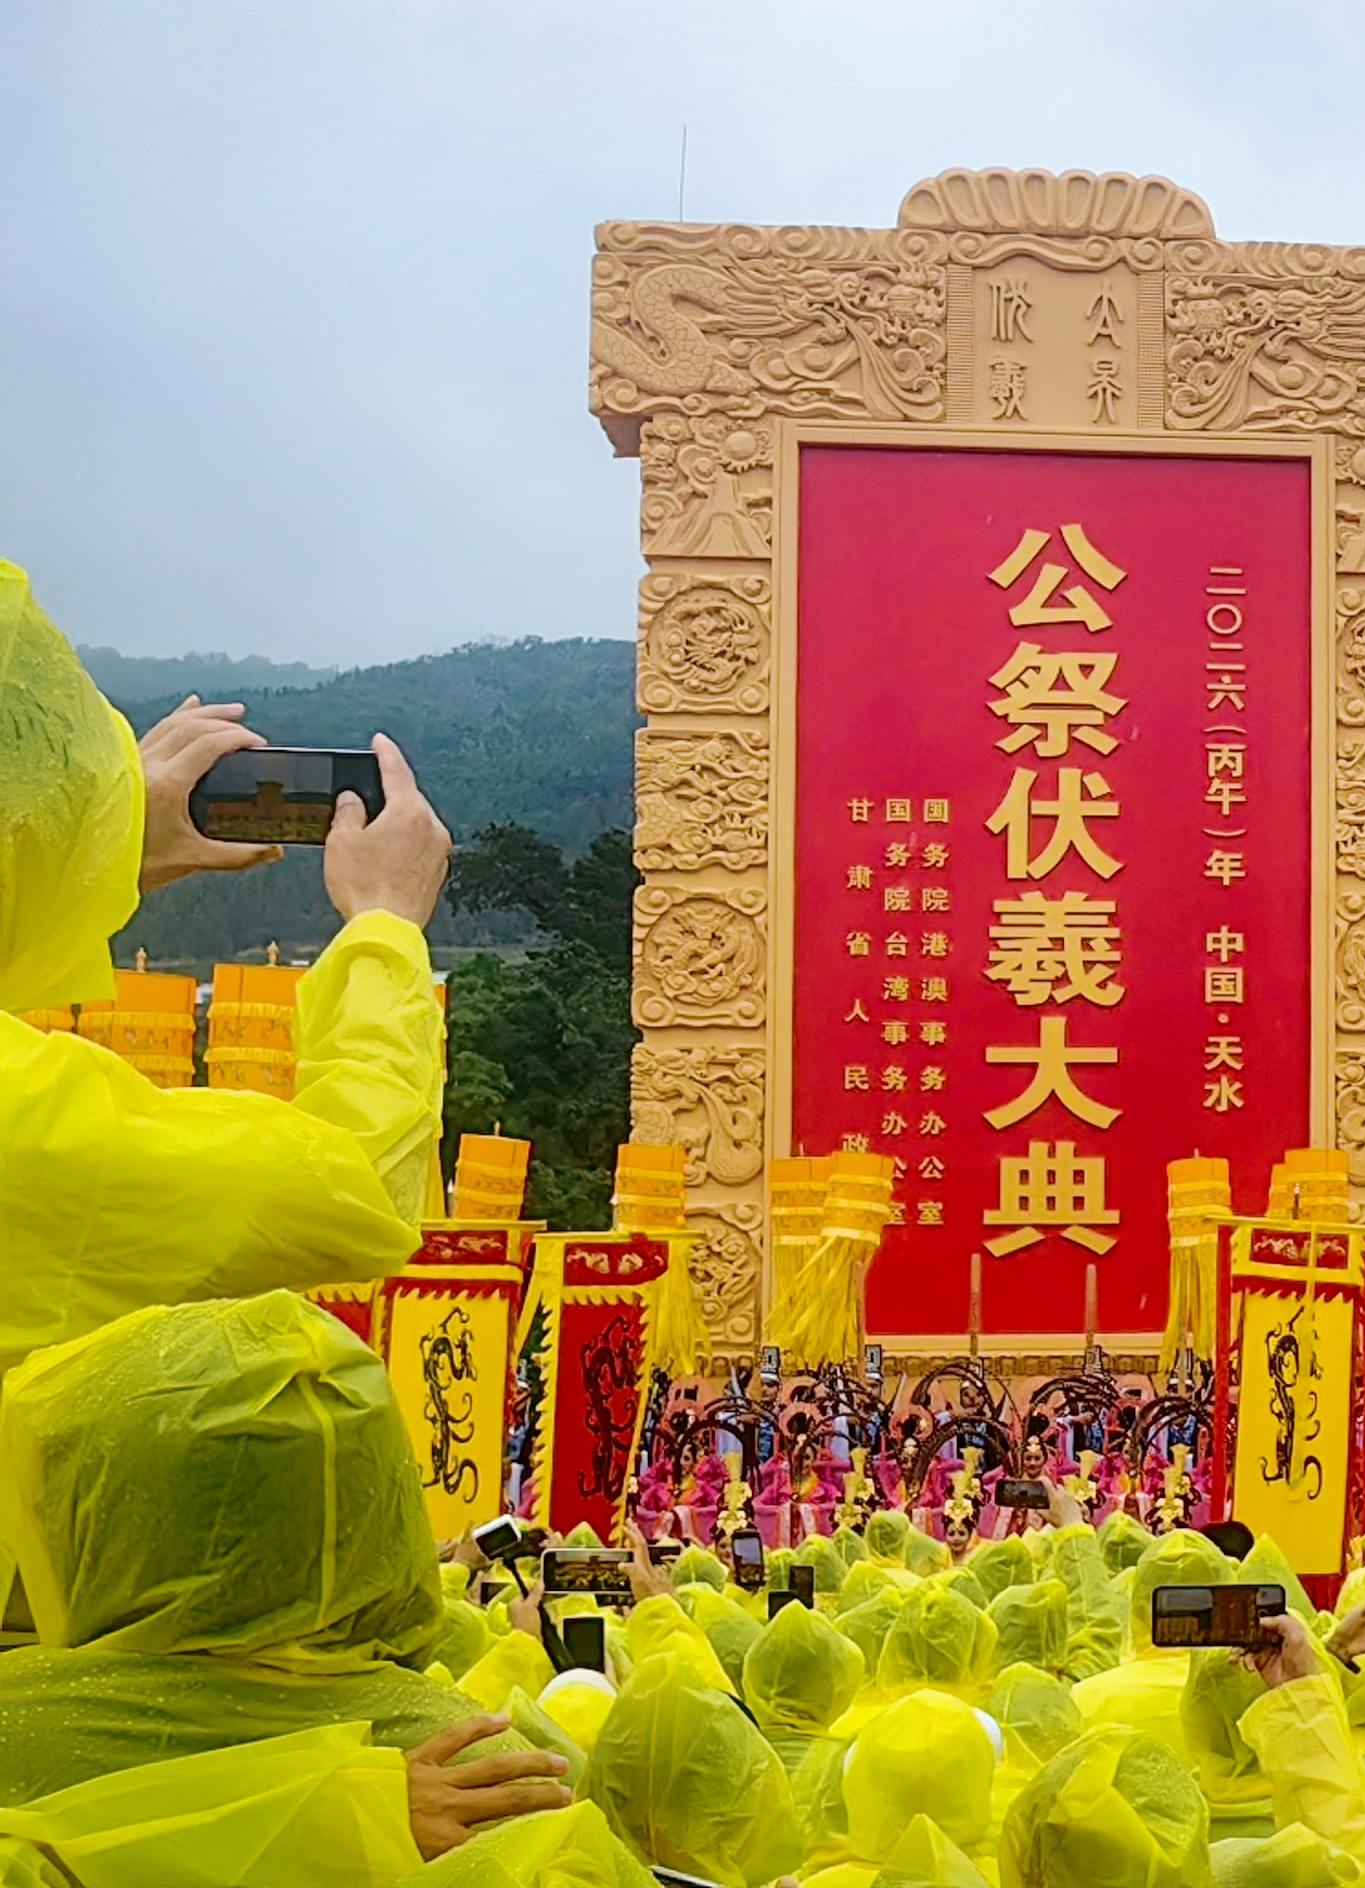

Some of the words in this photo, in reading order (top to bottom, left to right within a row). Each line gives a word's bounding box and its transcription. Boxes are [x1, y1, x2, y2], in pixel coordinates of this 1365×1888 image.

[917, 798, 950, 1225] 国务院港澳事务办公室
[984, 523, 1127, 1257] 公祭伏羲大典
